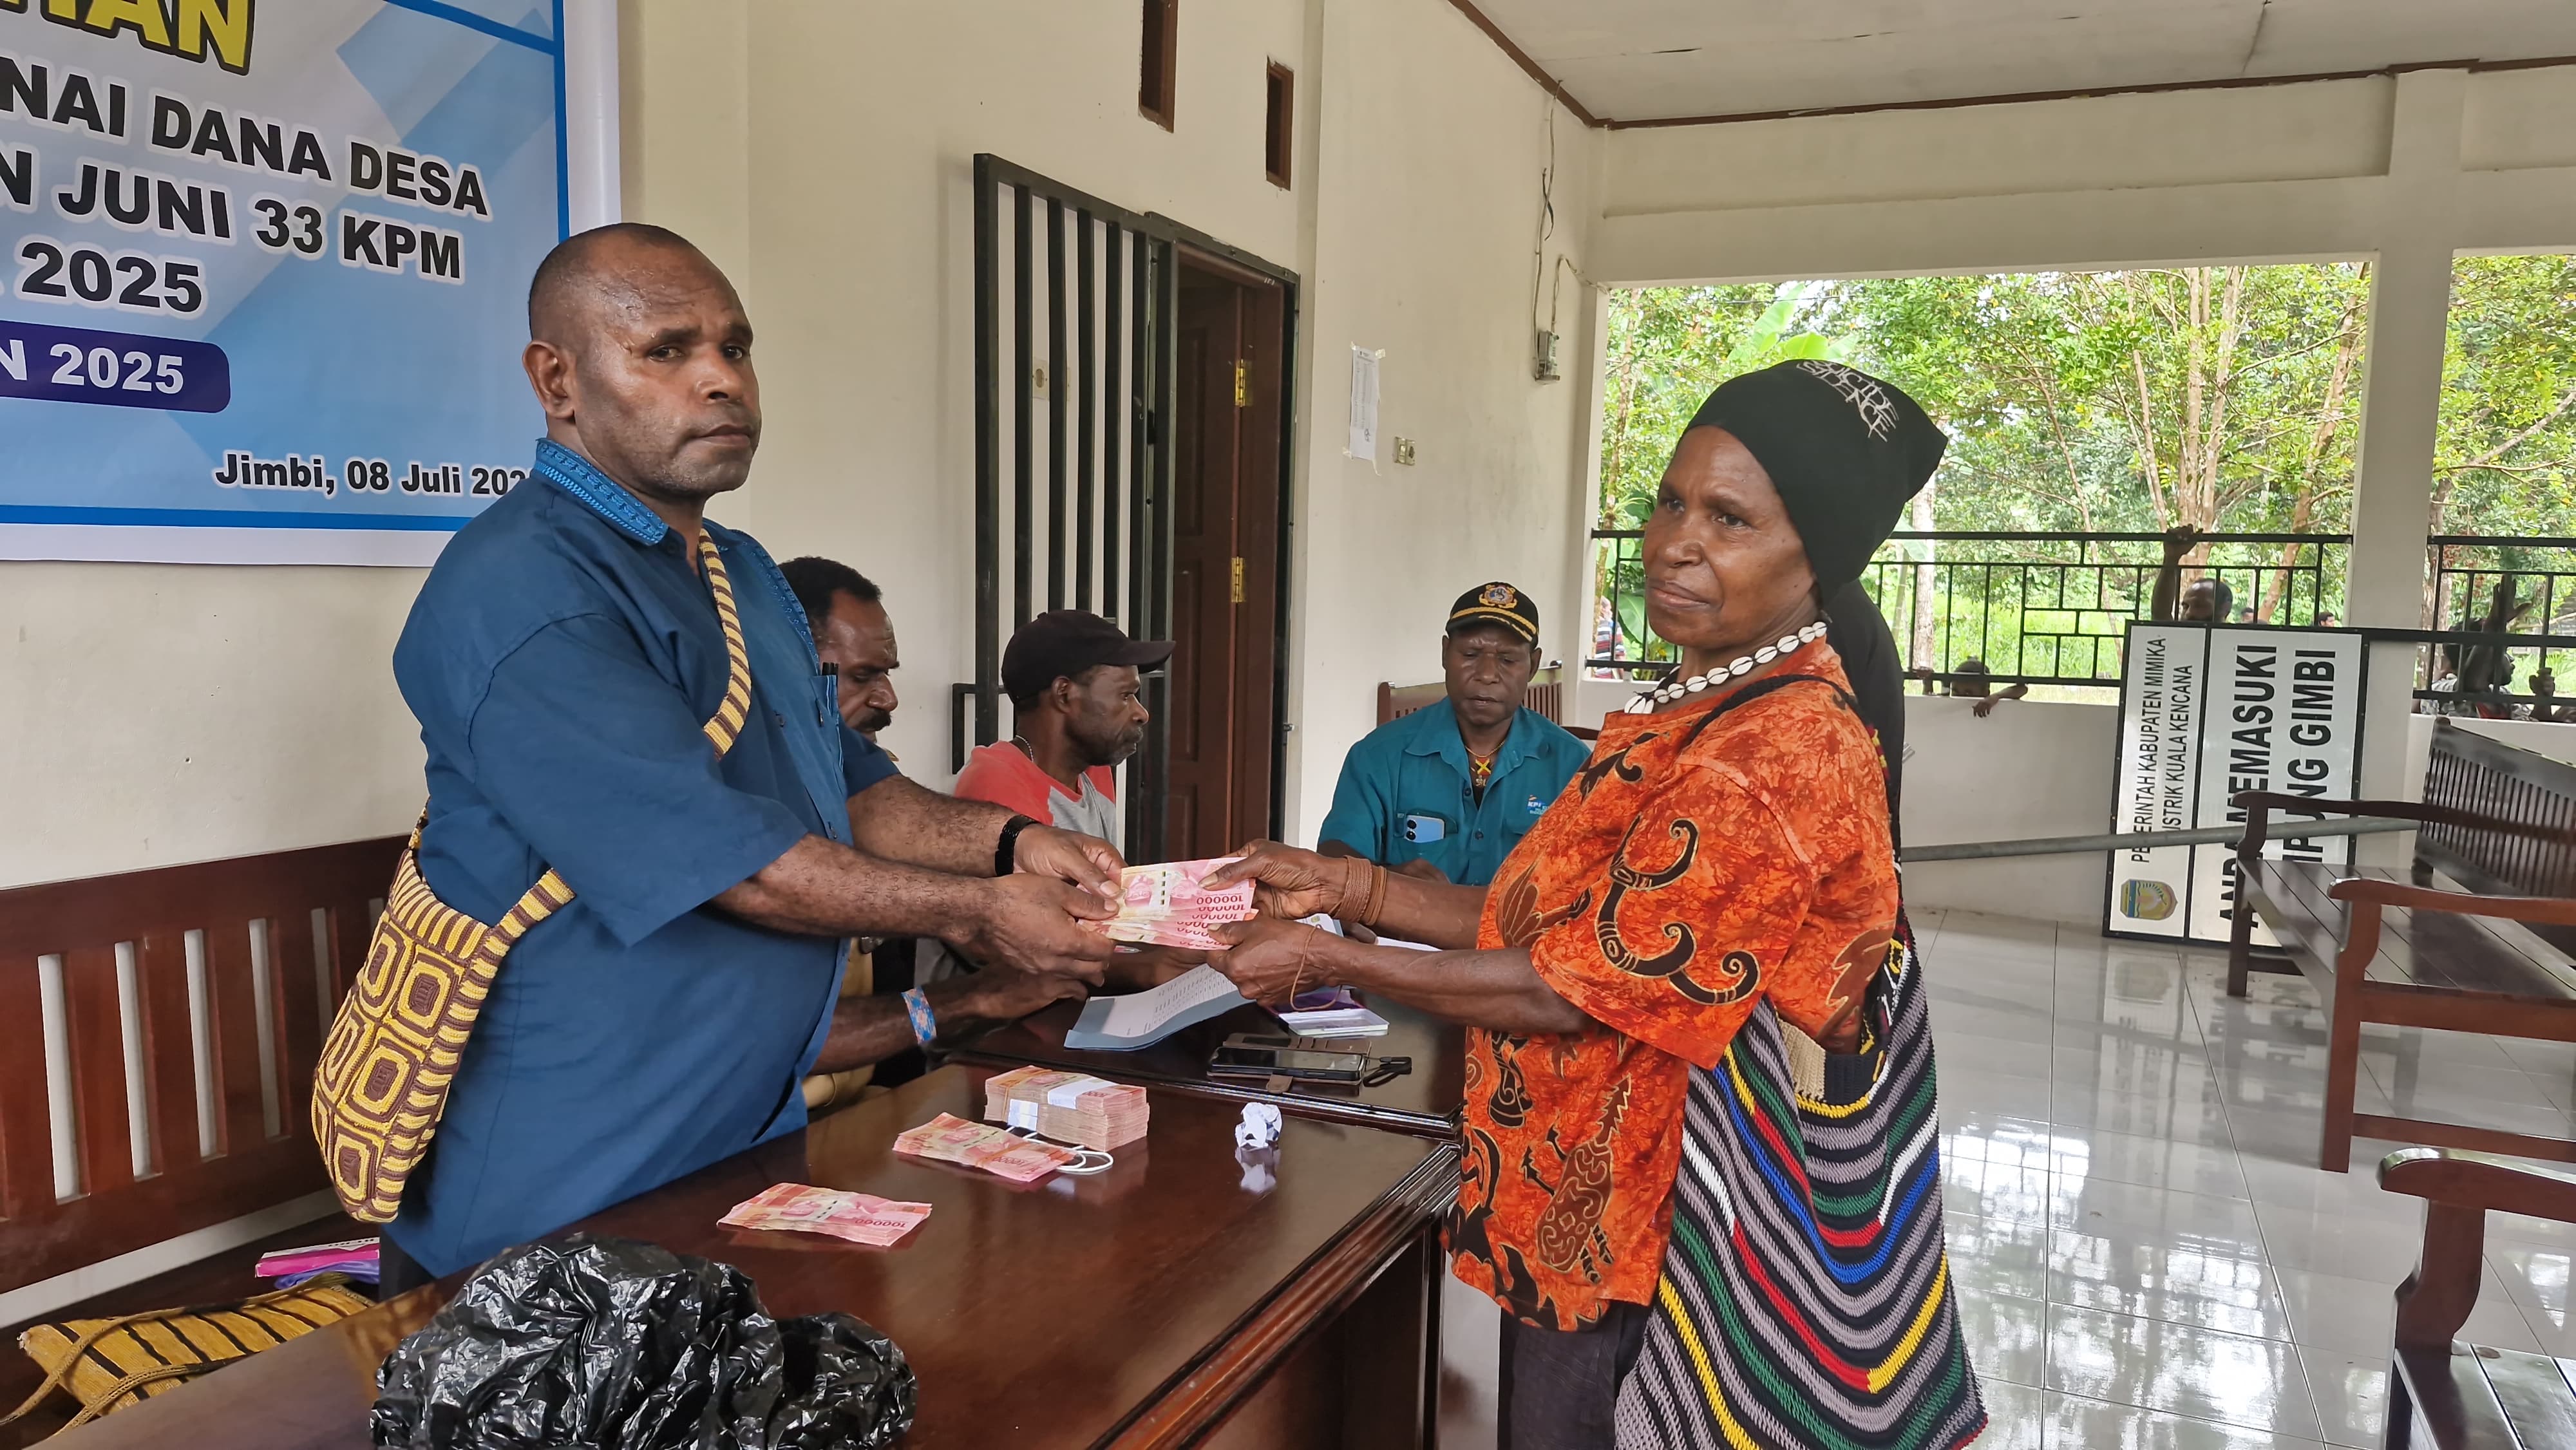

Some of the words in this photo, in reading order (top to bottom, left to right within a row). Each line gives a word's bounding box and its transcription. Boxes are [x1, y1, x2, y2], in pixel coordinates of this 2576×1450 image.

[0, 56, 126, 137] NAI
[152, 95, 332, 181] DANA
[351, 142, 488, 216] DESA
[59, 165, 231, 239] JUNI
[255, 200, 323, 254] 33
[344, 216, 460, 279] KPM
[22, 242, 202, 312] 2025
[50, 343, 184, 394] 2025
[216, 453, 334, 495] Jimbi,
[347, 460, 390, 491] 08
[401, 464, 460, 493] Juli
[2144, 638, 2166, 686] MIMIKA
[2138, 691, 2162, 771] KABUPATEN
[2170, 665, 2193, 731] KENCANA
[2289, 650, 2336, 746] GIMBI
[2165, 736, 2187, 781] KUALA
[2131, 777, 2156, 863] PEERINTAH
[2161, 786, 2184, 831] ISTRIK
[1197, 895, 1244, 905] 100000
